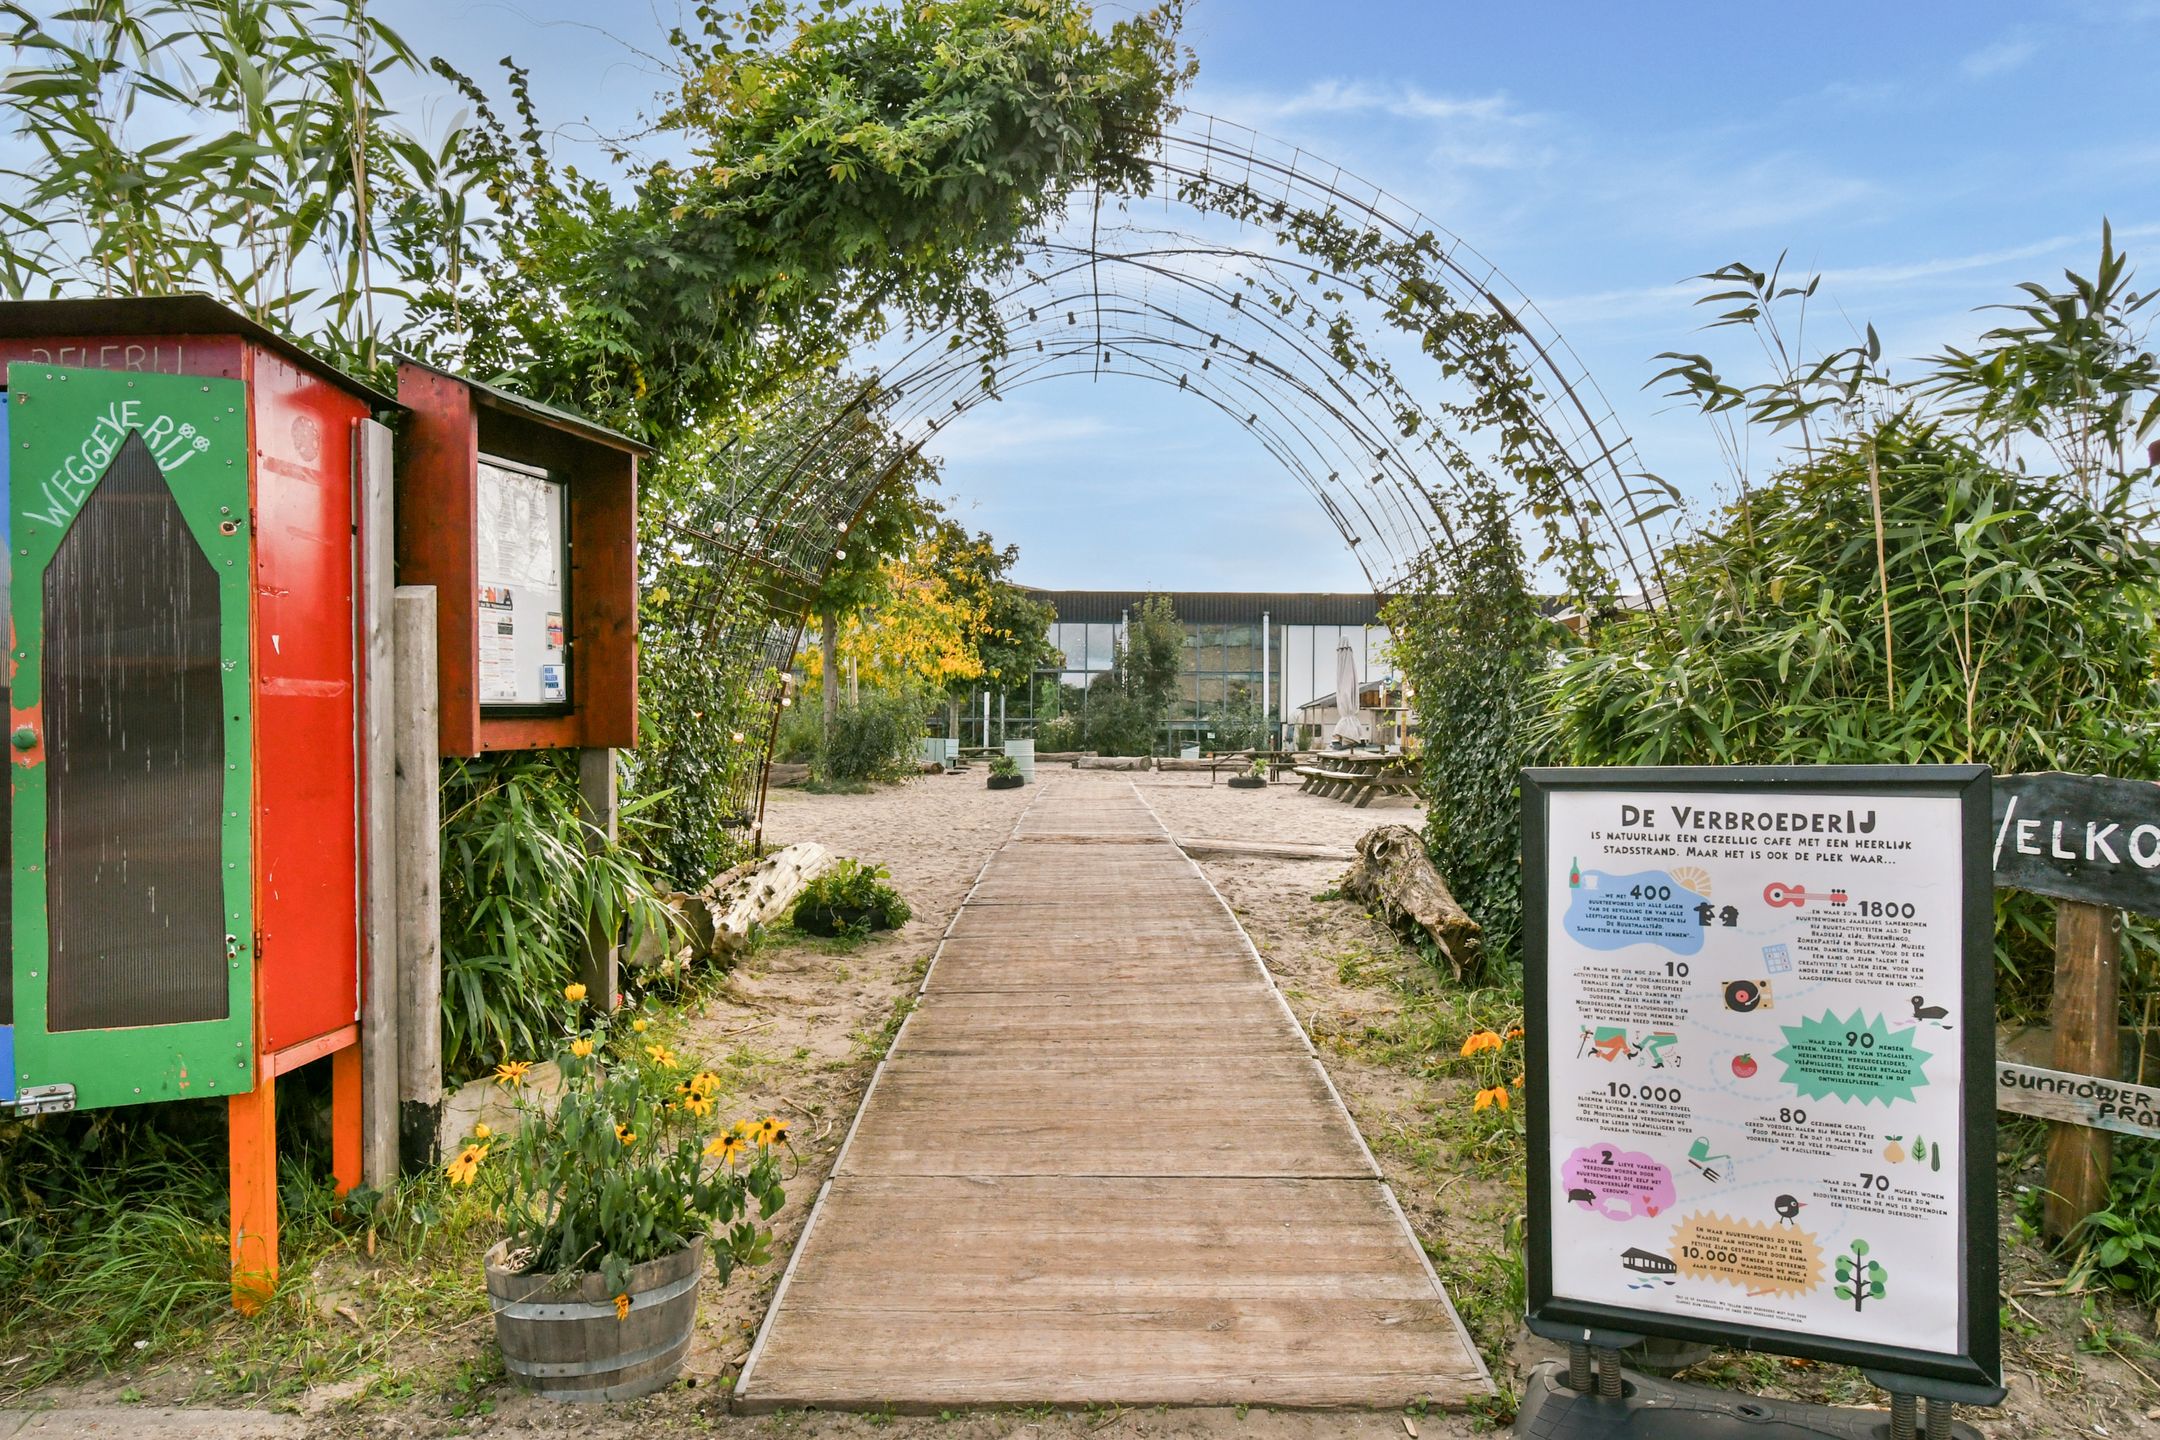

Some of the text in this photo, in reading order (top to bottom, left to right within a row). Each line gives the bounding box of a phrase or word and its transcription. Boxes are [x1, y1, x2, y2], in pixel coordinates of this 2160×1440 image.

[22, 400, 199, 529] WEGGEVERIJ
[1621, 805, 1876, 834] DE VERBROEDERIJ
[1592, 832, 1911, 850] IS NATUURLIJK EEN GEZELLIG CAFE MET EEN HEERLIJK
[1604, 845, 1896, 864] STADSSTRAND. MAAR HET IS OOK DE PLEK WAAR...
[1630, 885, 1671, 901] 400
[1858, 901, 1915, 919] 1800
[1823, 924, 1882, 933] BUURTACTIVITEITEN
[1885, 920, 1926, 928] SAMENKOMEN
[1665, 962, 1689, 978] 10
[1798, 960, 1837, 968] CREATIVITEIT
[1799, 975, 1851, 983] LAAGDREMPELIGE
[1845, 1031, 1874, 1049] 90
[1608, 1082, 1682, 1103] 10.000
[1779, 1108, 1807, 1124] 80
[1811, 1121, 1842, 1129] GEZINNEN
[1601, 1150, 1614, 1165] 2
[1860, 1173, 1890, 1191] 70
[1894, 1188, 1917, 1196] MUSJES
[1921, 1192, 1944, 1200] WONEN
[1813, 1191, 1859, 1203] BIODIVERSITEIT
[1911, 1206, 1947, 1216] BOVENDIEN
[1681, 1245, 1738, 1264] 10.000
